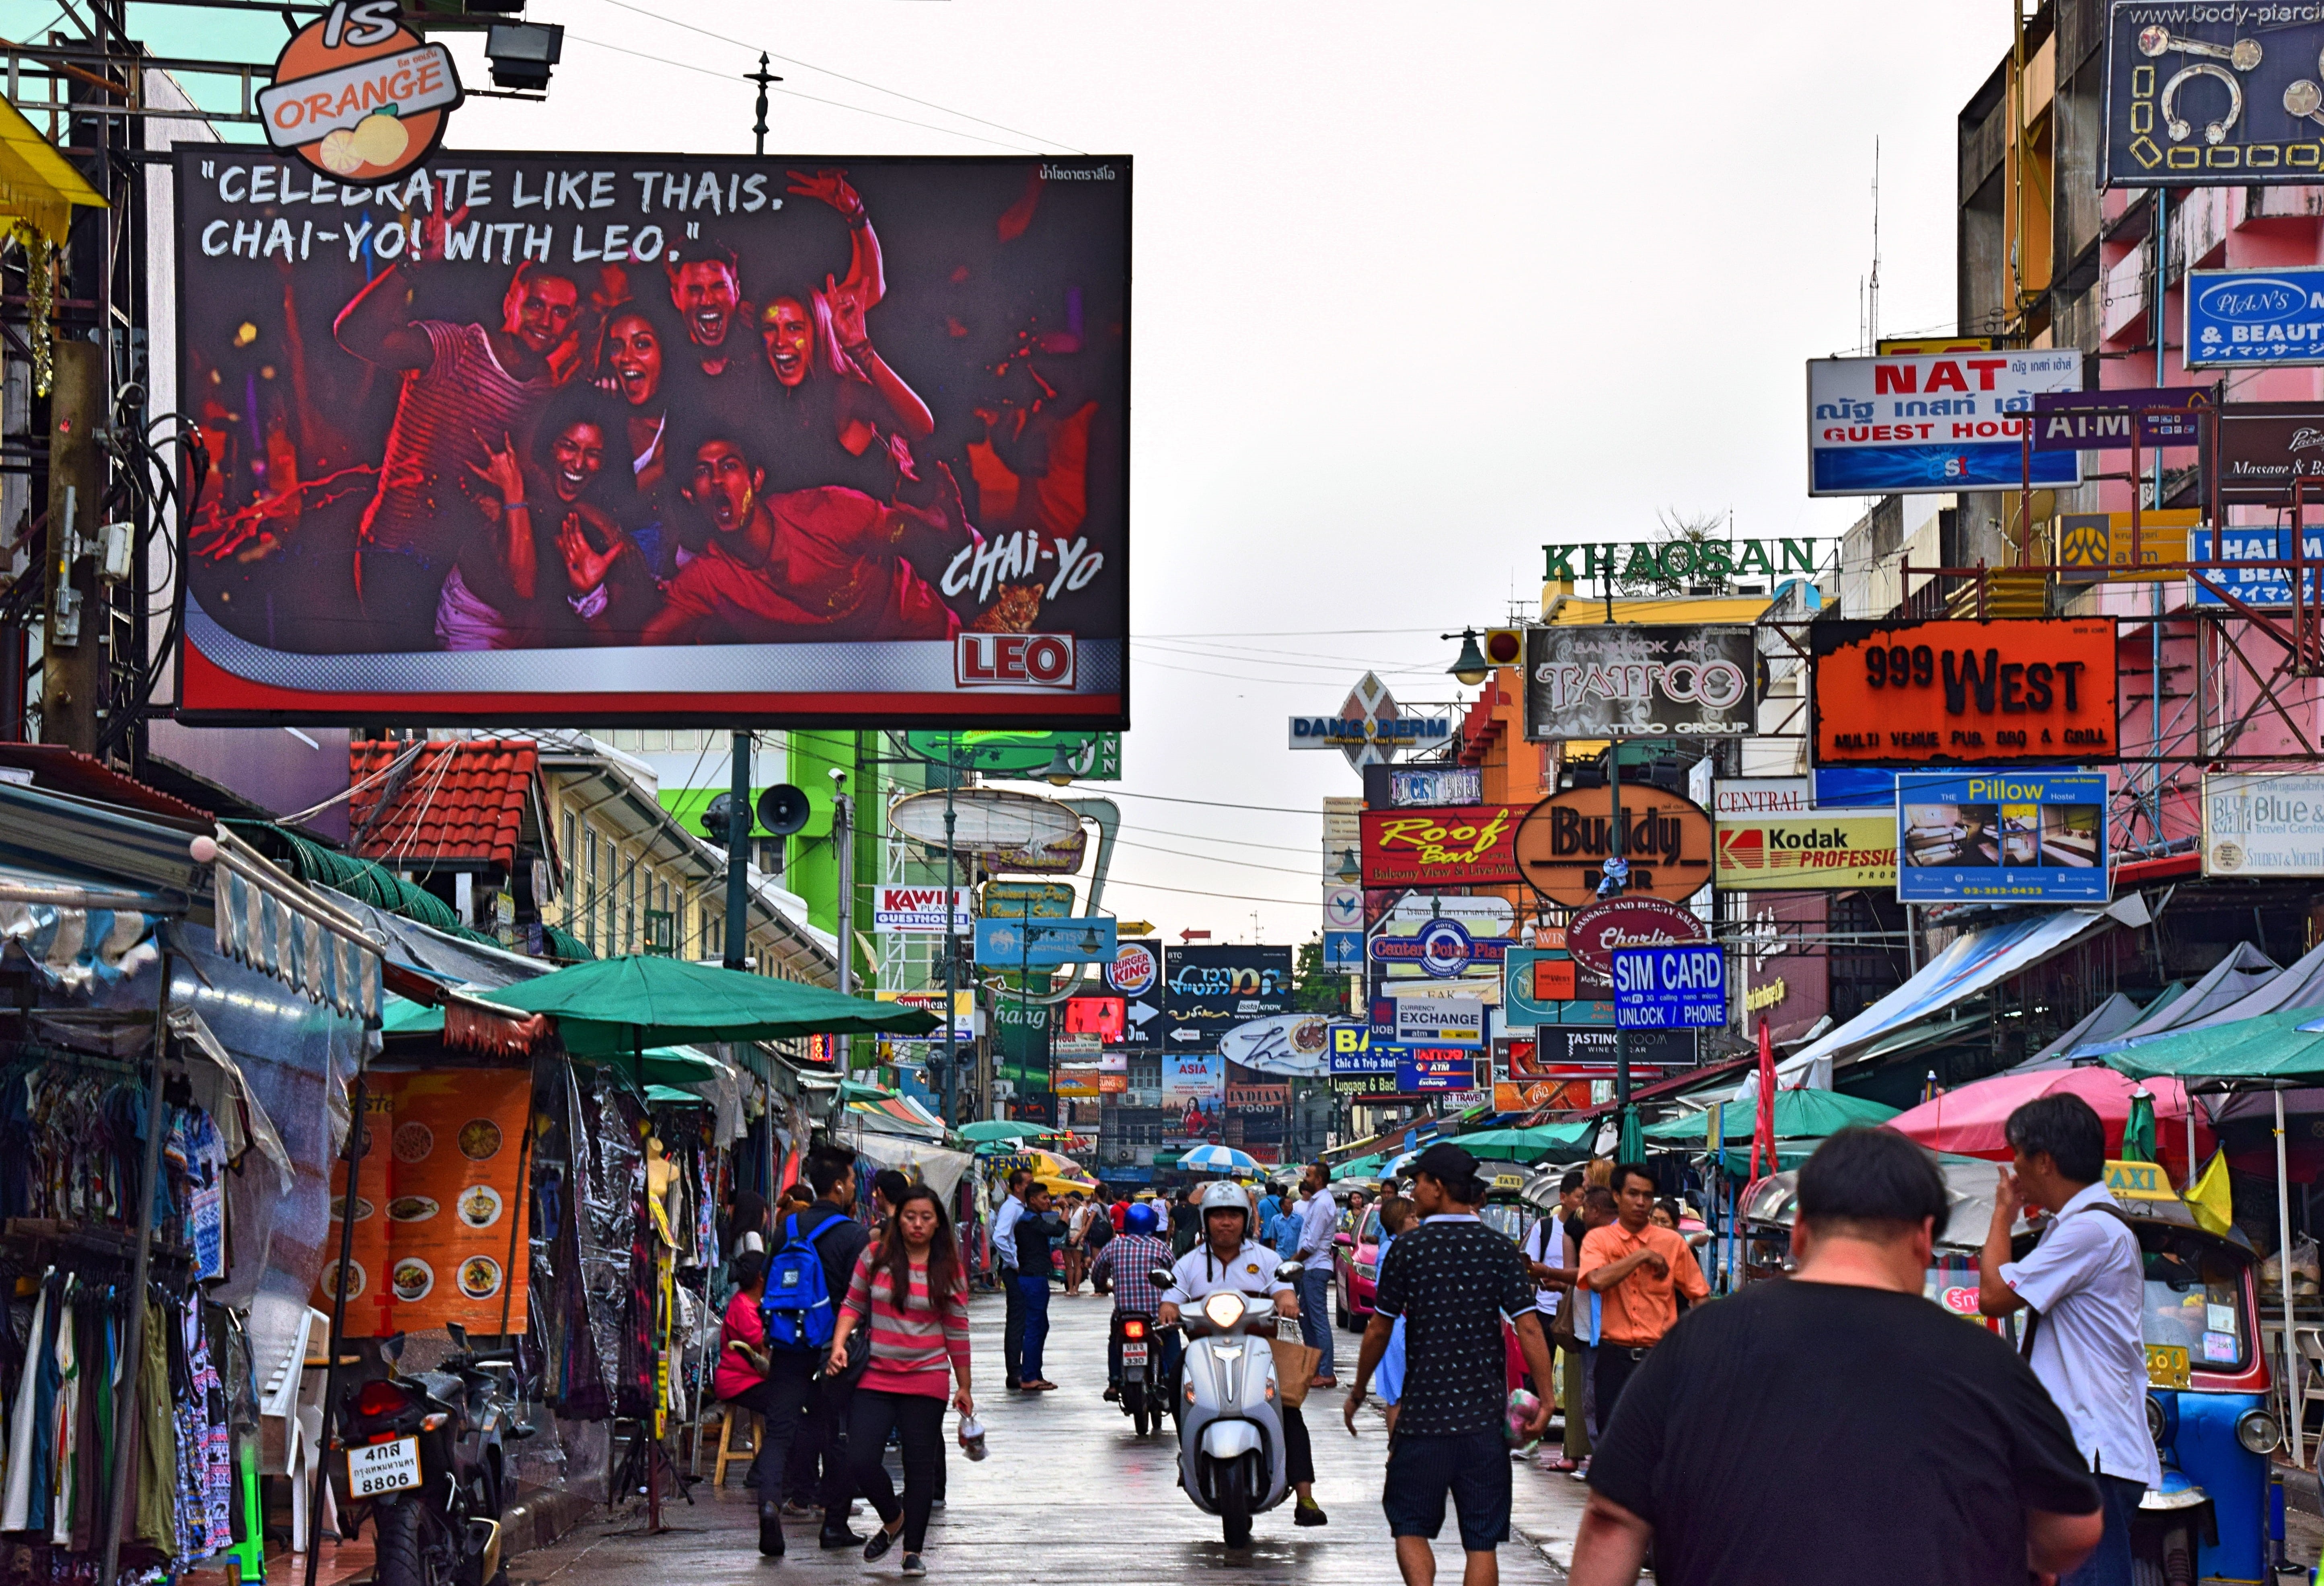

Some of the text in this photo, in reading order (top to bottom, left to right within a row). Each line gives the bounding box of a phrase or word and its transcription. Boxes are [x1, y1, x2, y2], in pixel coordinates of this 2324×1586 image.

[324, 0, 398, 47] IS
[274, 61, 443, 129] ORANGE
[513, 170, 615, 210] LIKE
[633, 171, 783, 215] THAIS.
[201, 218, 699, 265] CHAI-YO! WITH LEO."
[2201, 323, 2324, 343] & BEAUT
[1875, 359, 2007, 396] NAT
[1816, 398, 1874, 424] ณัฐ
[1823, 421, 2032, 443] GUEST HOU
[1927, 455, 1968, 480] est
[2293, 459, 2305, 474] &
[2115, 532, 2158, 541] krugsri
[2205, 539, 2277, 560] THAI
[1542, 538, 1816, 582] KHAOSAN
[1574, 640, 1708, 654] BANGKOK ART
[963, 636, 1070, 683] LEO
[1865, 645, 1932, 689] 999
[1535, 659, 1748, 711] TATTOO
[1294, 719, 1447, 737] DANG DERM
[1587, 723, 1667, 735] TATTOO
[1675, 722, 1749, 734] GROUP
[1835, 734, 1879, 749] MULTI
[1890, 731, 1940, 748] VENUE
[2064, 728, 2107, 745] GRILL
[1444, 775, 1481, 798] BEER
[1969, 780, 2044, 800] Pillow
[1718, 791, 1803, 812] CENTRAL
[2255, 795, 2308, 823] Blue
[1379, 809, 1509, 853] Roof
[1551, 805, 1681, 867] Buddy
[1769, 827, 1848, 849] Kodak
[2256, 824, 2324, 834] Travel Cente
[1417, 844, 1479, 864] Bar
[1374, 865, 1493, 881] Balcony View & Live
[885, 890, 960, 911] KAWIN
[1573, 902, 1702, 938] MASSAGE AND BEAUTY SALON
[1600, 927, 1675, 949] Charlie
[1376, 940, 1505, 958] Center Point Plaz
[1112, 953, 1148, 973] BURGER
[1423, 957, 1467, 973] SHOPPING MALL
[1617, 953, 1721, 992] SIM CARD
[1114, 963, 1150, 985] KING
[897, 998, 947, 1011] Southeas
[1400, 1012, 1479, 1025] EXCHANGE
[1619, 1005, 1723, 1026] UNLOCK / PHONE
[1058, 1035, 1076, 1043] TOUR
[1372, 1025, 1394, 1035] UOB
[1567, 1033, 1617, 1044] TASTING
[1179, 1064, 1208, 1074] ASIA
[1335, 1058, 1378, 1070] Chic & Trip
[1430, 1063, 1450, 1071] ATM
[1334, 1077, 1366, 1095] Luggage
[1370, 1077, 1376, 1092] &
[1230, 1091, 1282, 1102] INDIAN
[1238, 1104, 1275, 1113] FOOD
[988, 1156, 1033, 1169] HENNA
[1499, 1176, 1520, 1186] TAXI
[365, 1442, 401, 1461] 4กส
[362, 1472, 409, 1493] 8806
